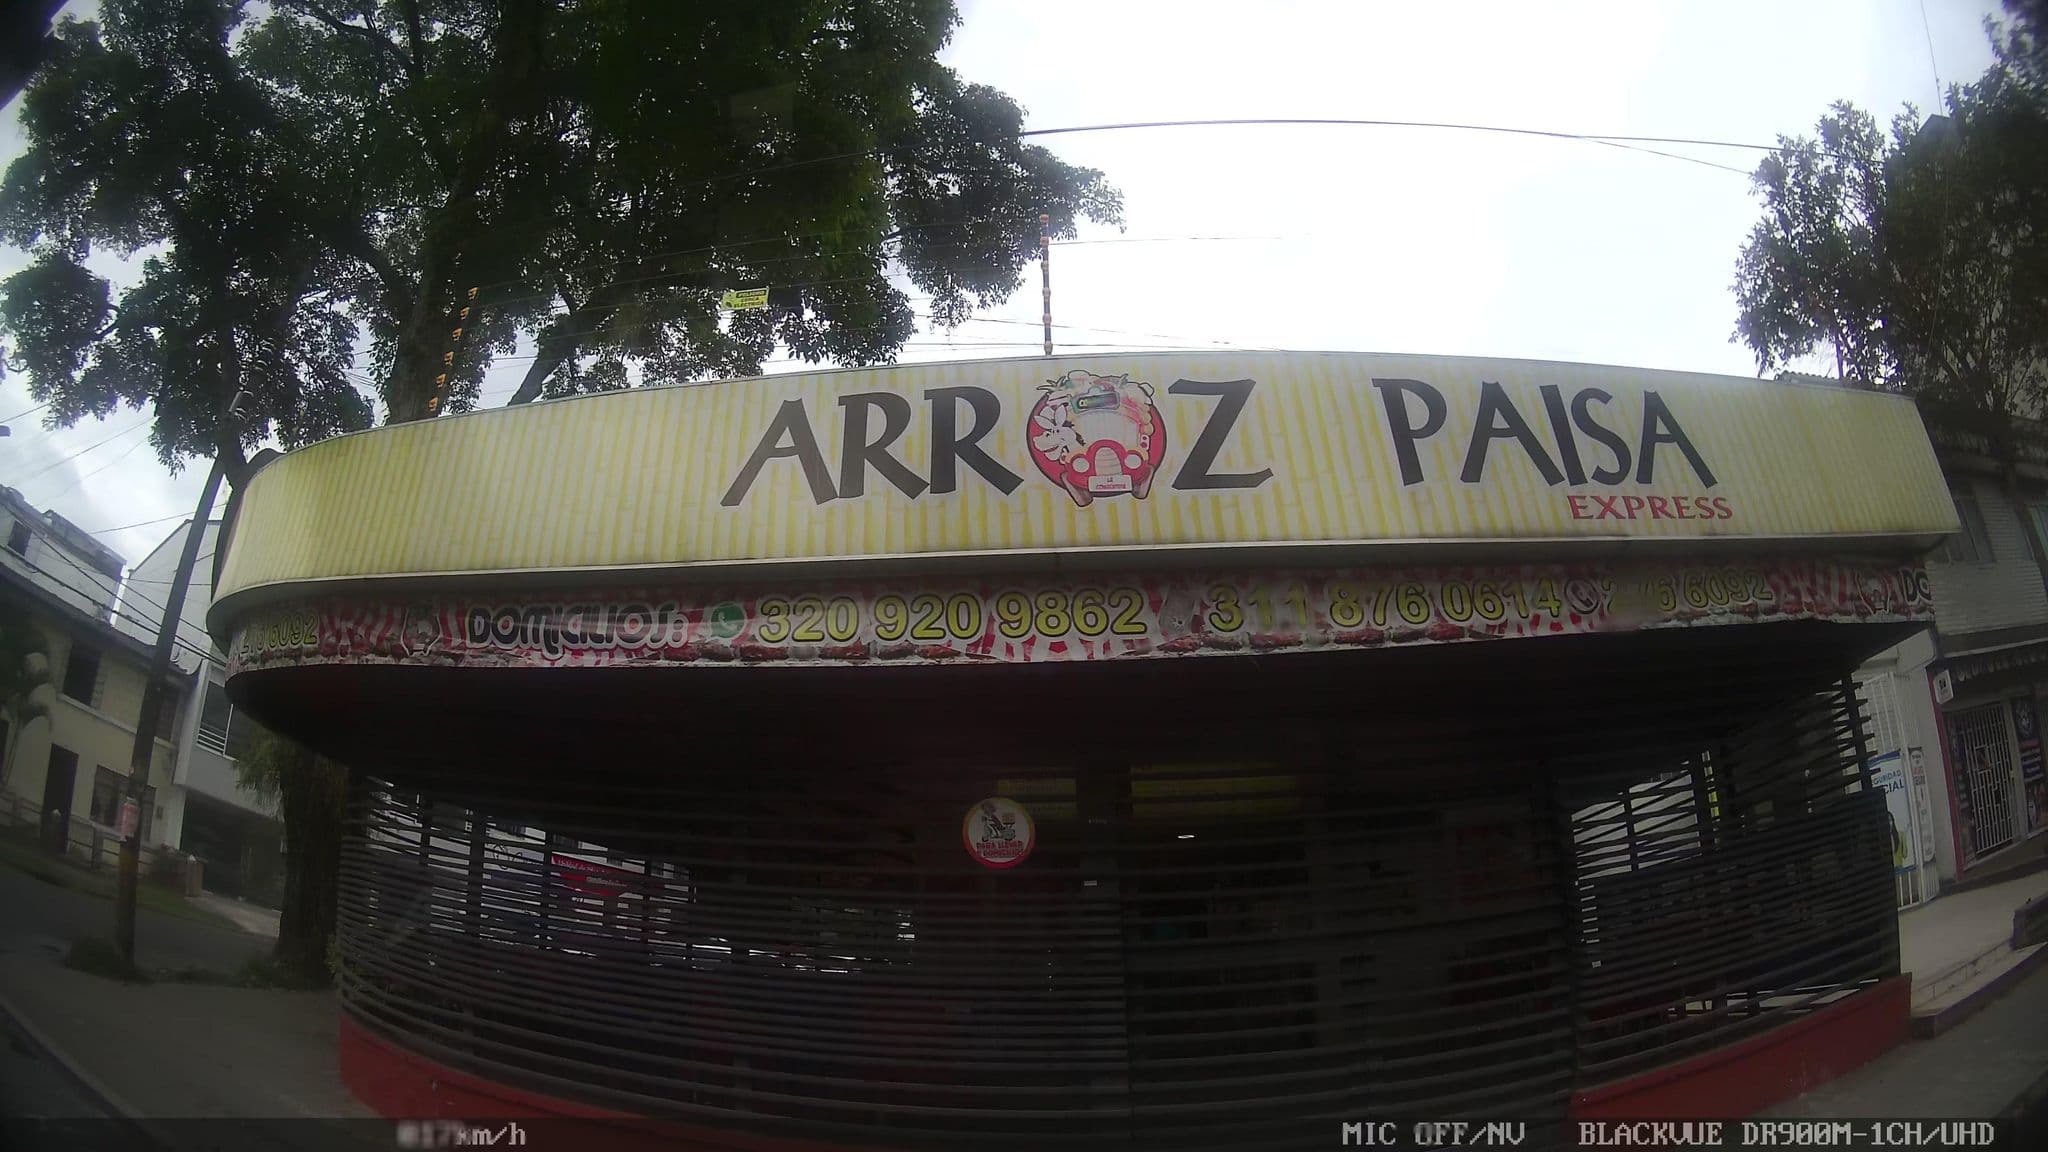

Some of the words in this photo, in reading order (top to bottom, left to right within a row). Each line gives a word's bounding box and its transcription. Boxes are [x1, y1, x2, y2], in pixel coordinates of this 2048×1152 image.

[1372, 377, 1718, 489] PAISA
[1566, 495, 1733, 520] EXPRESS
[758, 593, 860, 644] 320
[874, 592, 982, 641] 920
[997, 586, 1147, 639] 9862
[1208, 582, 1307, 633] 311
[1329, 578, 1431, 628] 876
[1441, 576, 1562, 622] 0614
